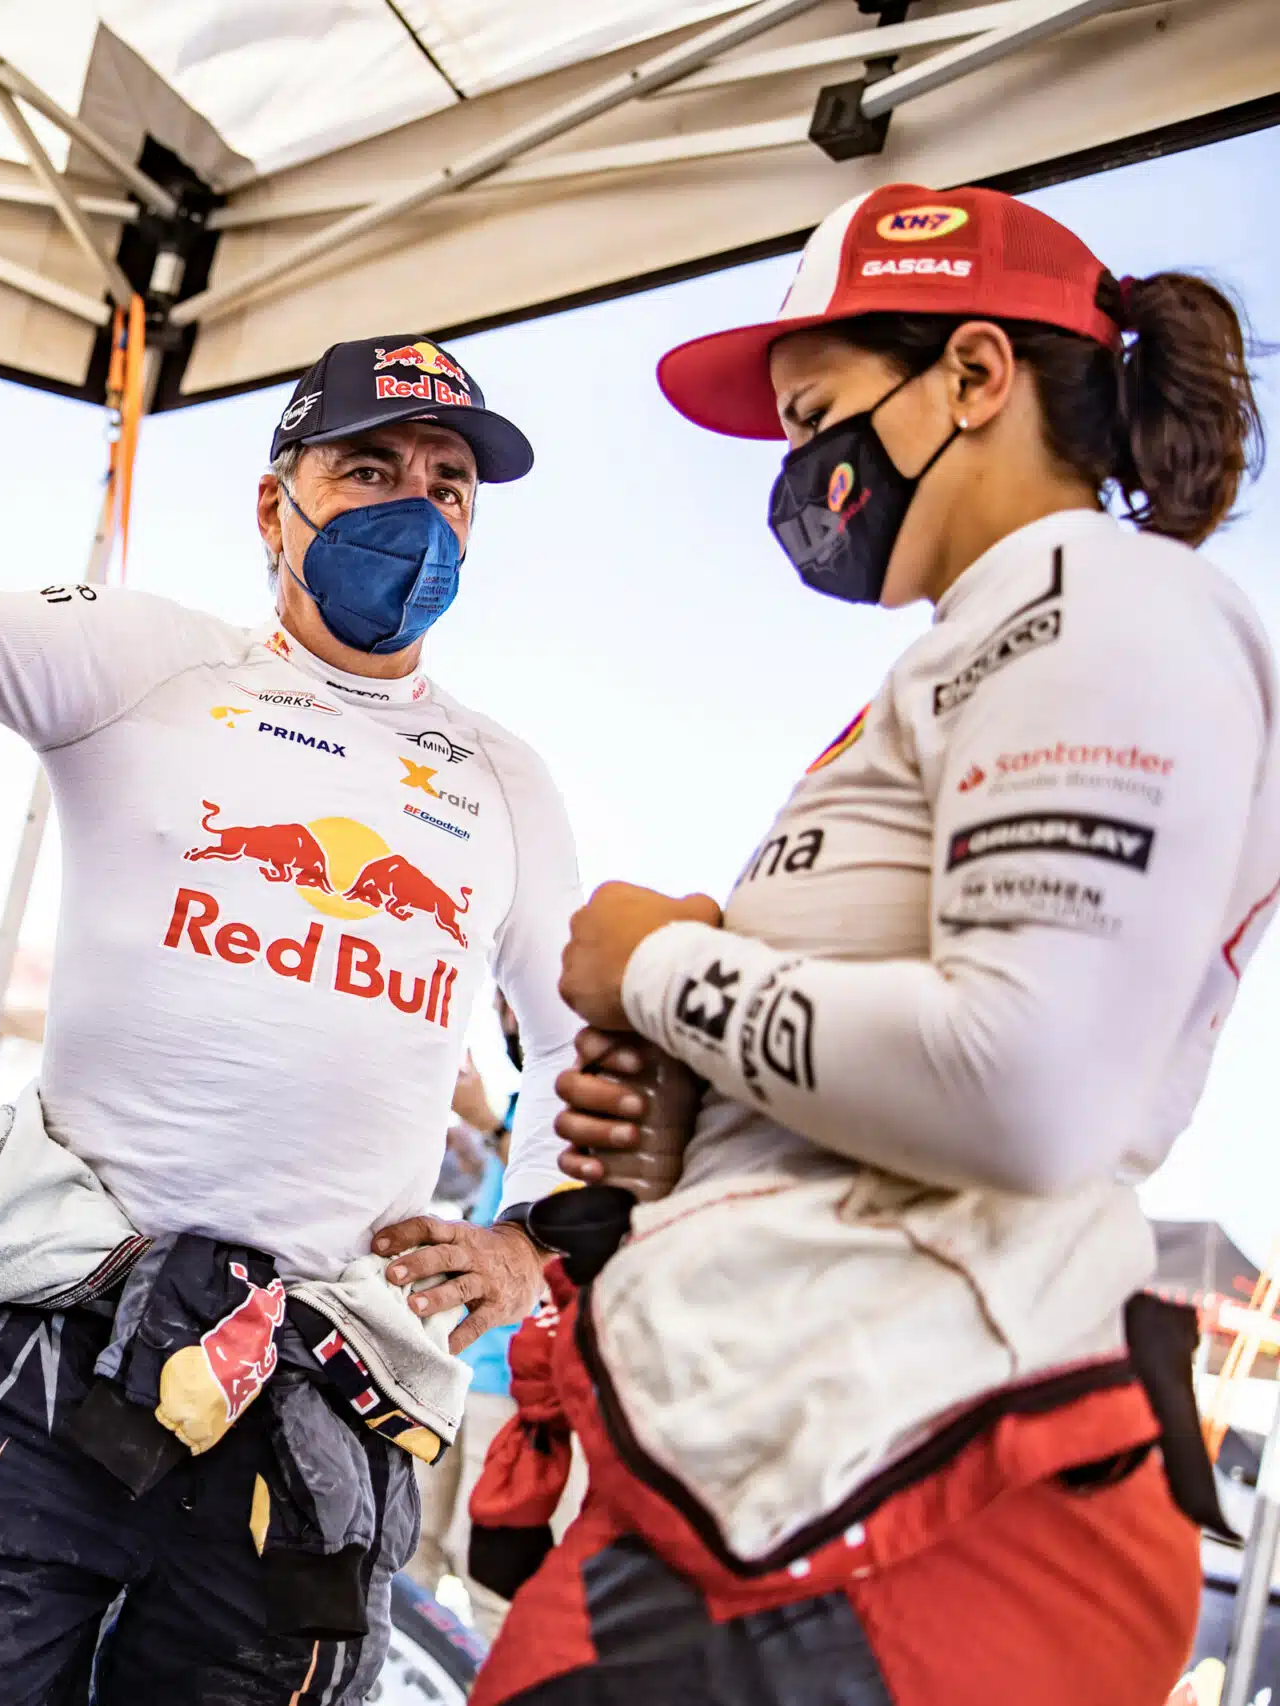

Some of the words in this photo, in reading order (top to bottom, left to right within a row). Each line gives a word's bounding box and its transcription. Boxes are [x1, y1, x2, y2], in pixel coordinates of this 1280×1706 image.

[861, 257, 972, 277] GASGAS
[376, 375, 431, 399] Red
[434, 380, 471, 407] Bull
[258, 693, 314, 708] WORKS
[258, 721, 347, 758] PRIMAX
[422, 739, 450, 756] MINI
[403, 803, 470, 840] BFGoodrich
[163, 887, 324, 983] Red
[334, 934, 458, 1028] Bull
